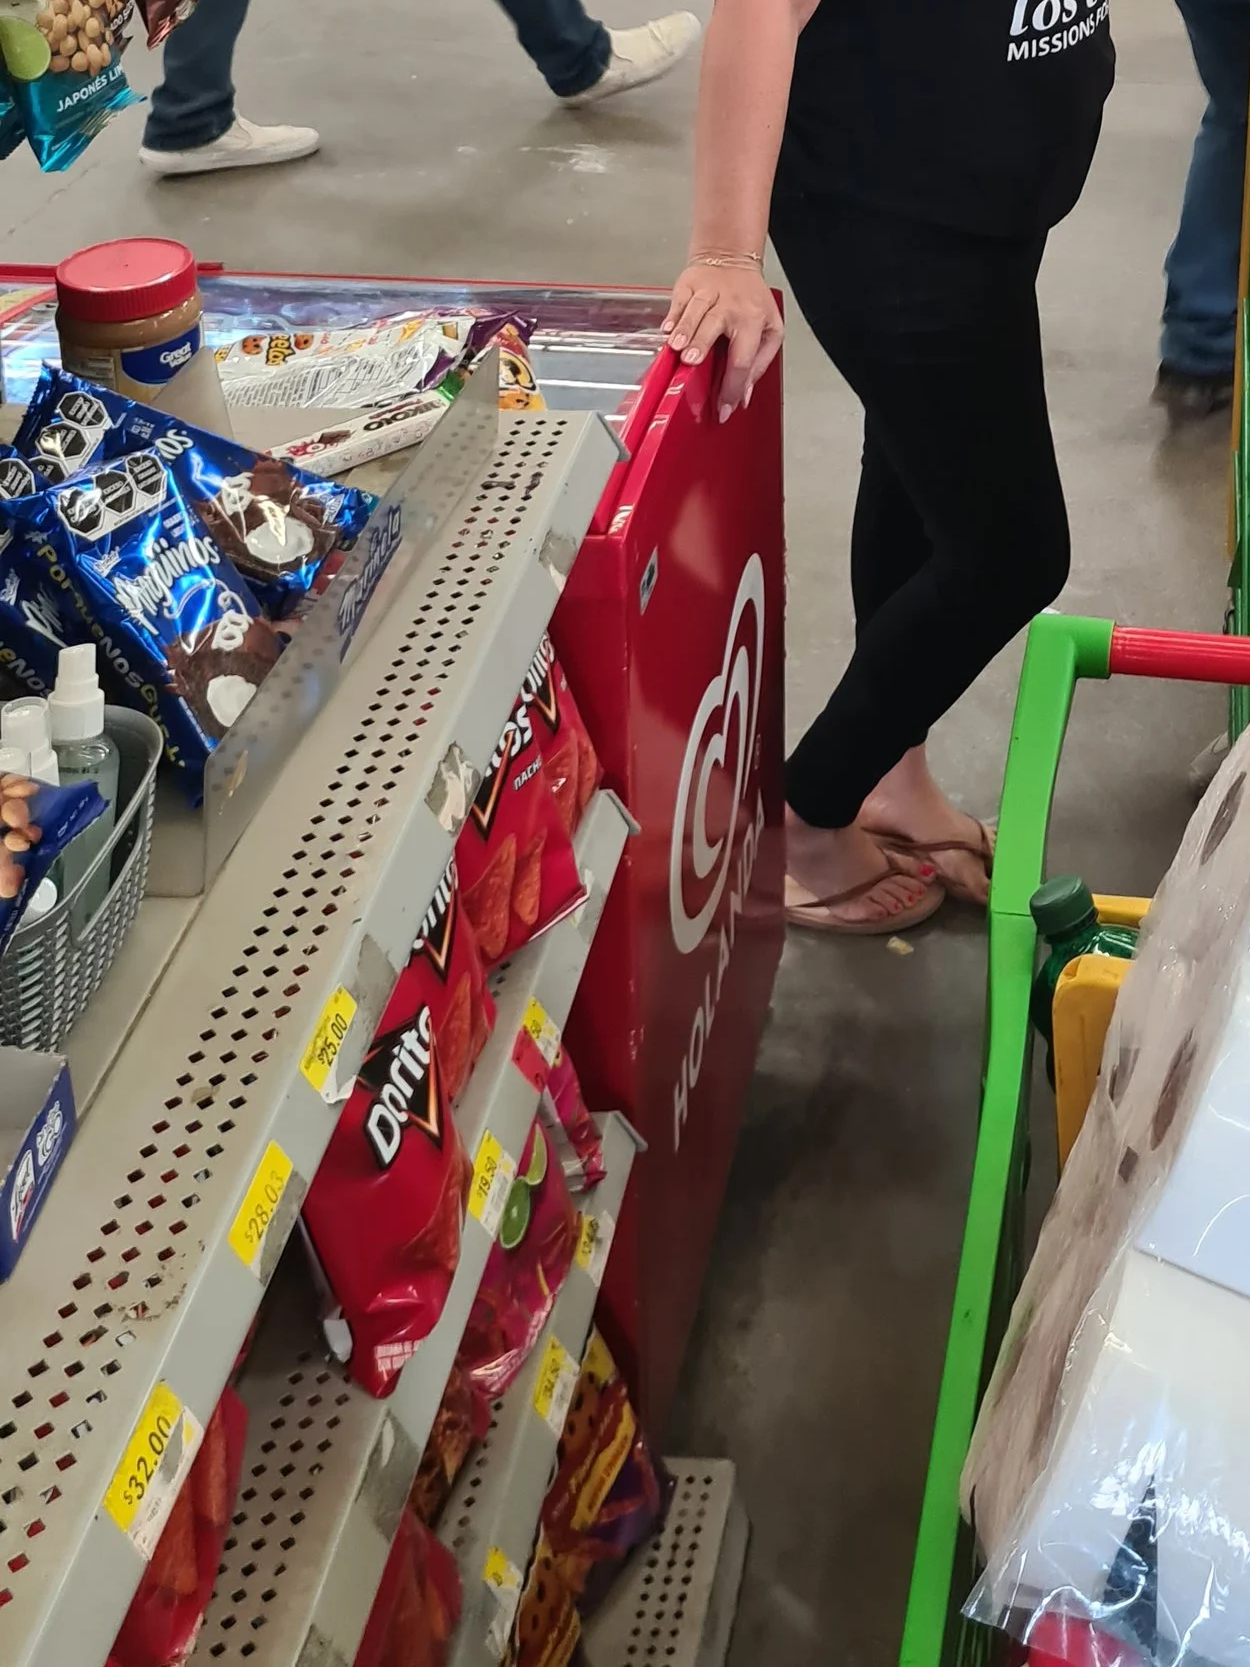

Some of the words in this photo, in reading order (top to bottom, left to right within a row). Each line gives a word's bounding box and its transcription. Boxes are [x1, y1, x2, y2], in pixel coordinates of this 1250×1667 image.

[1007, 13, 1095, 62] MISSIONS
[57, 72, 108, 112] JAPONÉS
[160, 340, 192, 366] Great
[674, 789, 766, 1154] HOLANDA
[317, 1013, 348, 1067] $25.00
[122, 1414, 172, 1505] $32.00
